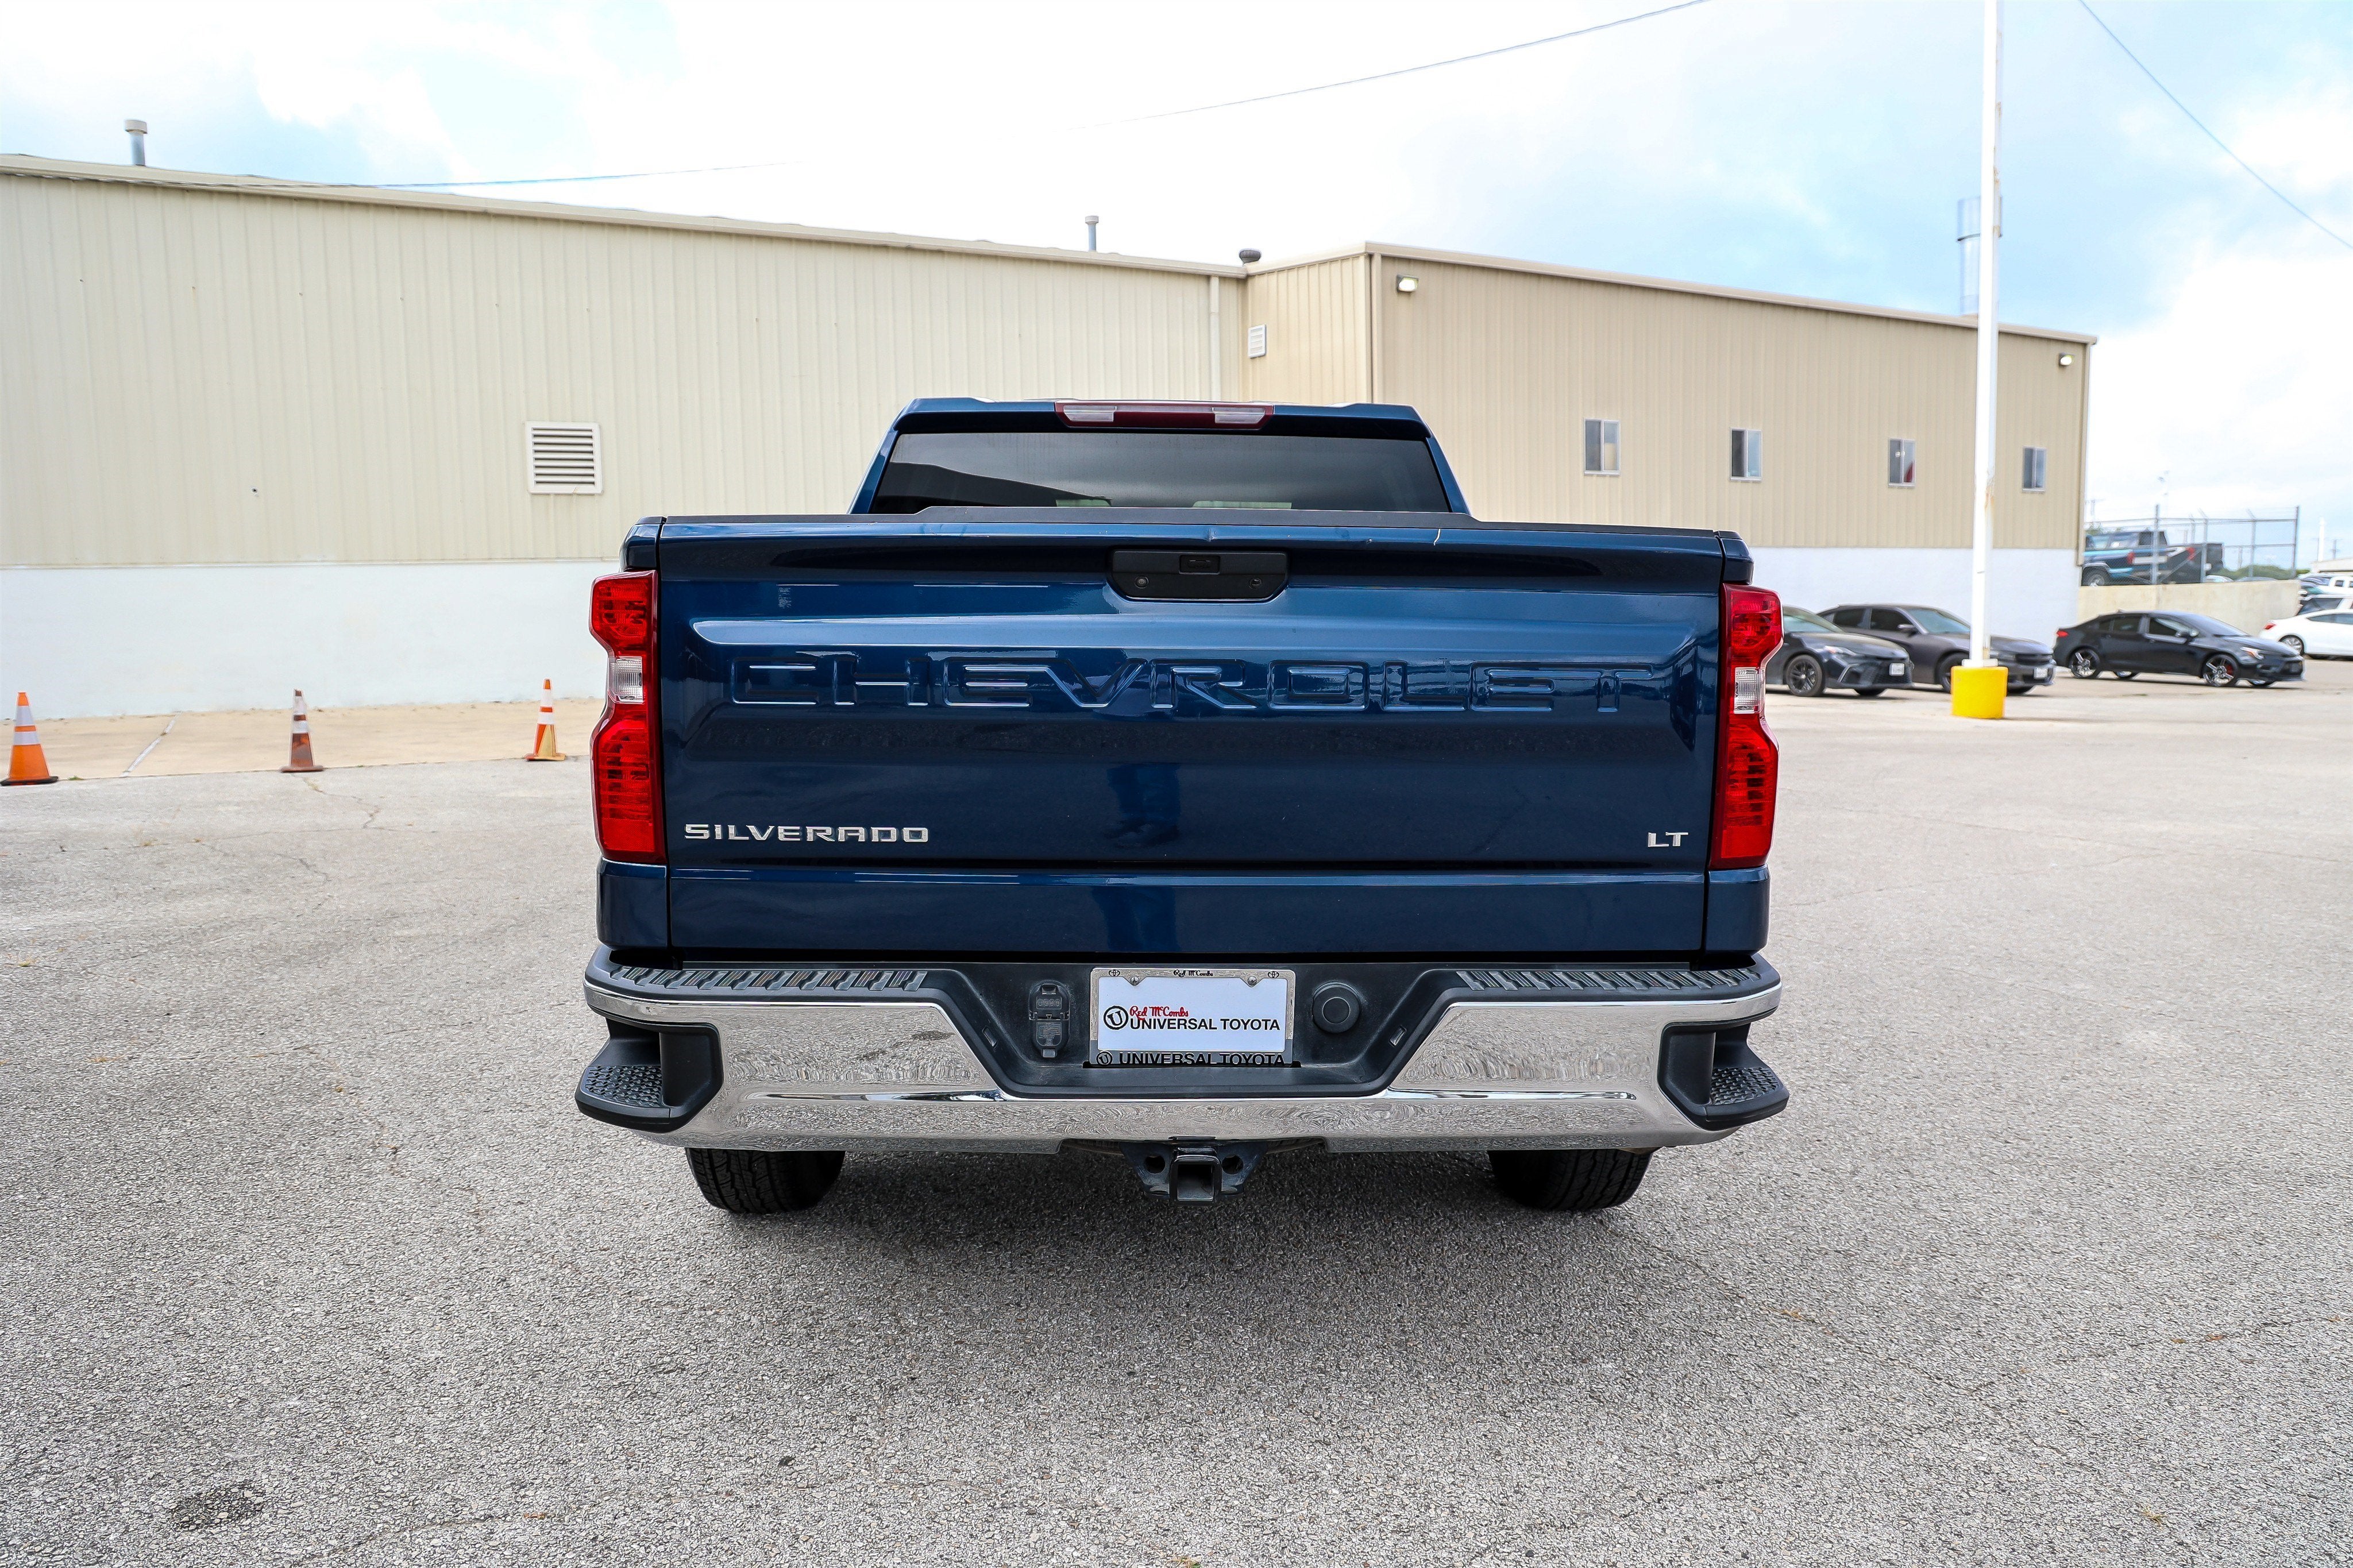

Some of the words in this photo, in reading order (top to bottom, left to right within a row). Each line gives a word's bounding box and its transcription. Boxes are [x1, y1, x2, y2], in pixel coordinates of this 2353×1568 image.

[731, 656, 1654, 712] CHEVROLET
[684, 824, 929, 843] SILVERADO
[1648, 832, 1689, 847] LT
[1129, 1005, 1148, 1021] Red
[1149, 1006, 1189, 1017] McCombs
[1130, 1018, 1217, 1030] UNIVERSAL
[1220, 1018, 1280, 1030] TOYOTA
[1119, 1052, 1217, 1065] UNIVERSAL
[1219, 1053, 1285, 1066] TOYOTA
